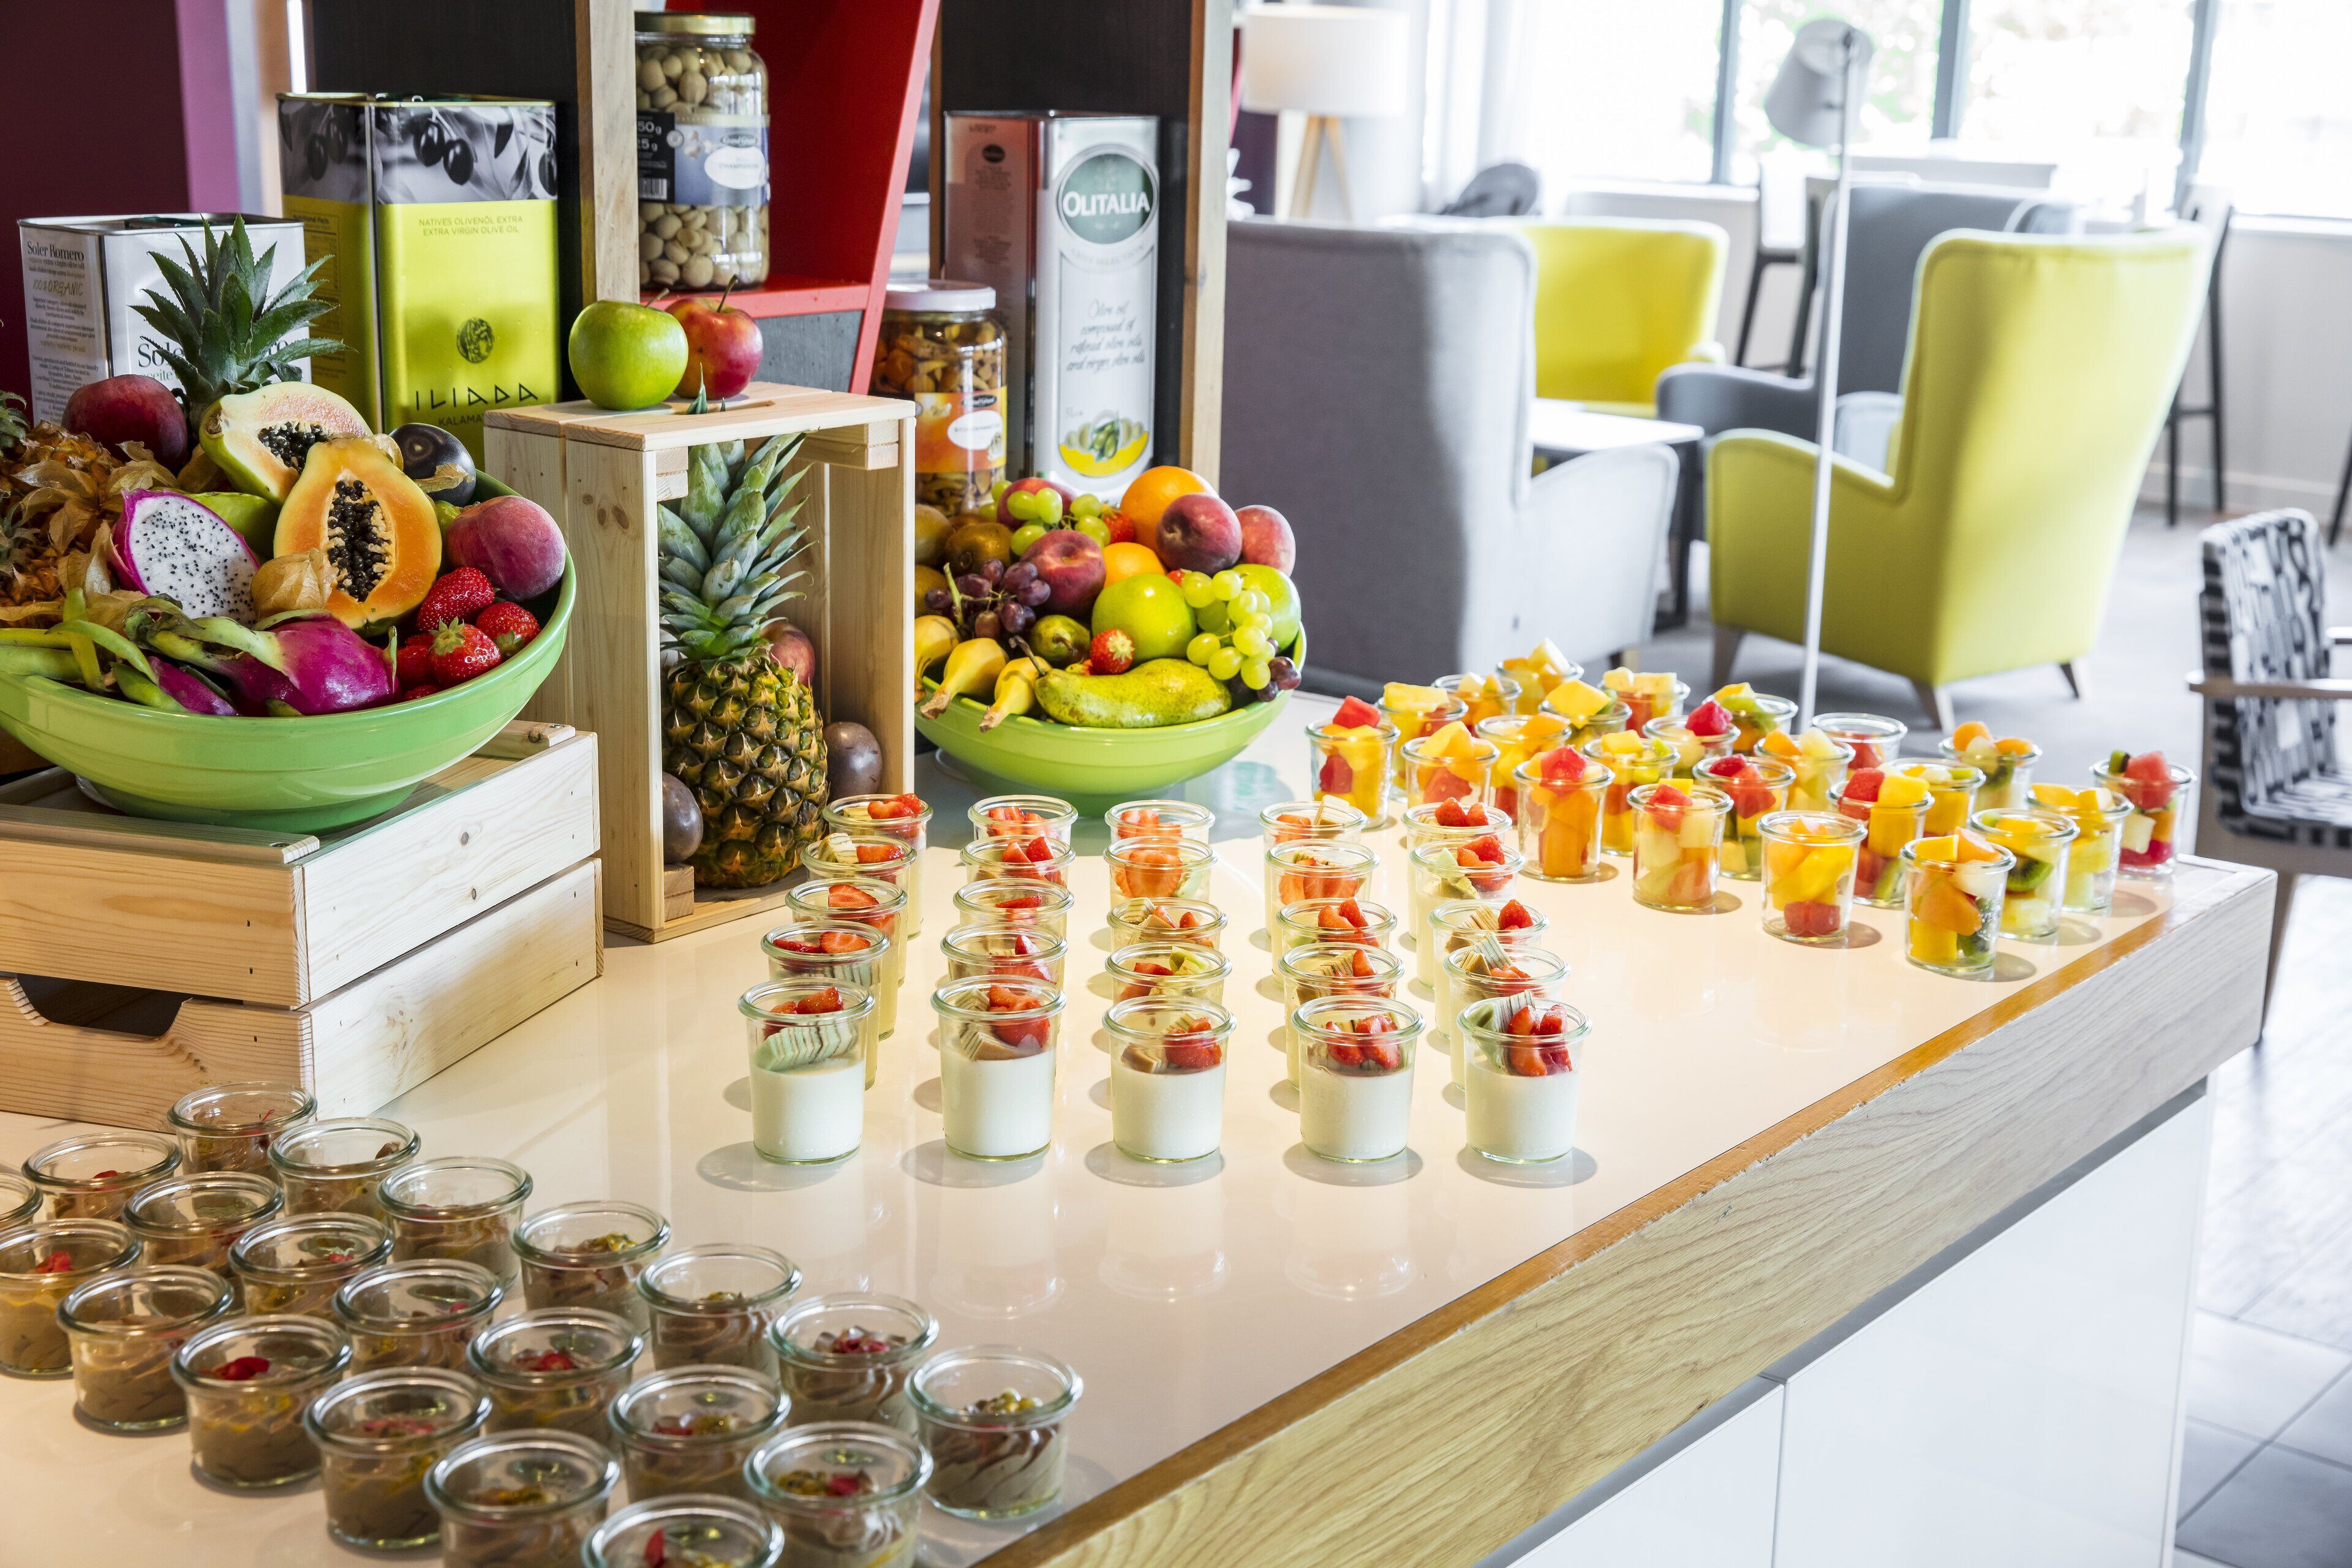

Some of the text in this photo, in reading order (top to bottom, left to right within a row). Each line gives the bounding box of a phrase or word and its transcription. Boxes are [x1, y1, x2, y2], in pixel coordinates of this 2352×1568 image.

[1063, 191, 1150, 217] OLITALIA
[419, 217, 451, 227] NATIVES
[454, 216, 494, 225] OLIVENÖL
[423, 227, 449, 236] EXTRA
[452, 226, 478, 235] VIRGIN
[481, 225, 503, 234] OLIVE
[28, 241, 84, 261] Soler Romero
[138, 341, 184, 368] Sole
[416, 382, 538, 411] ILIADA
[439, 413, 484, 426] KALAMA
